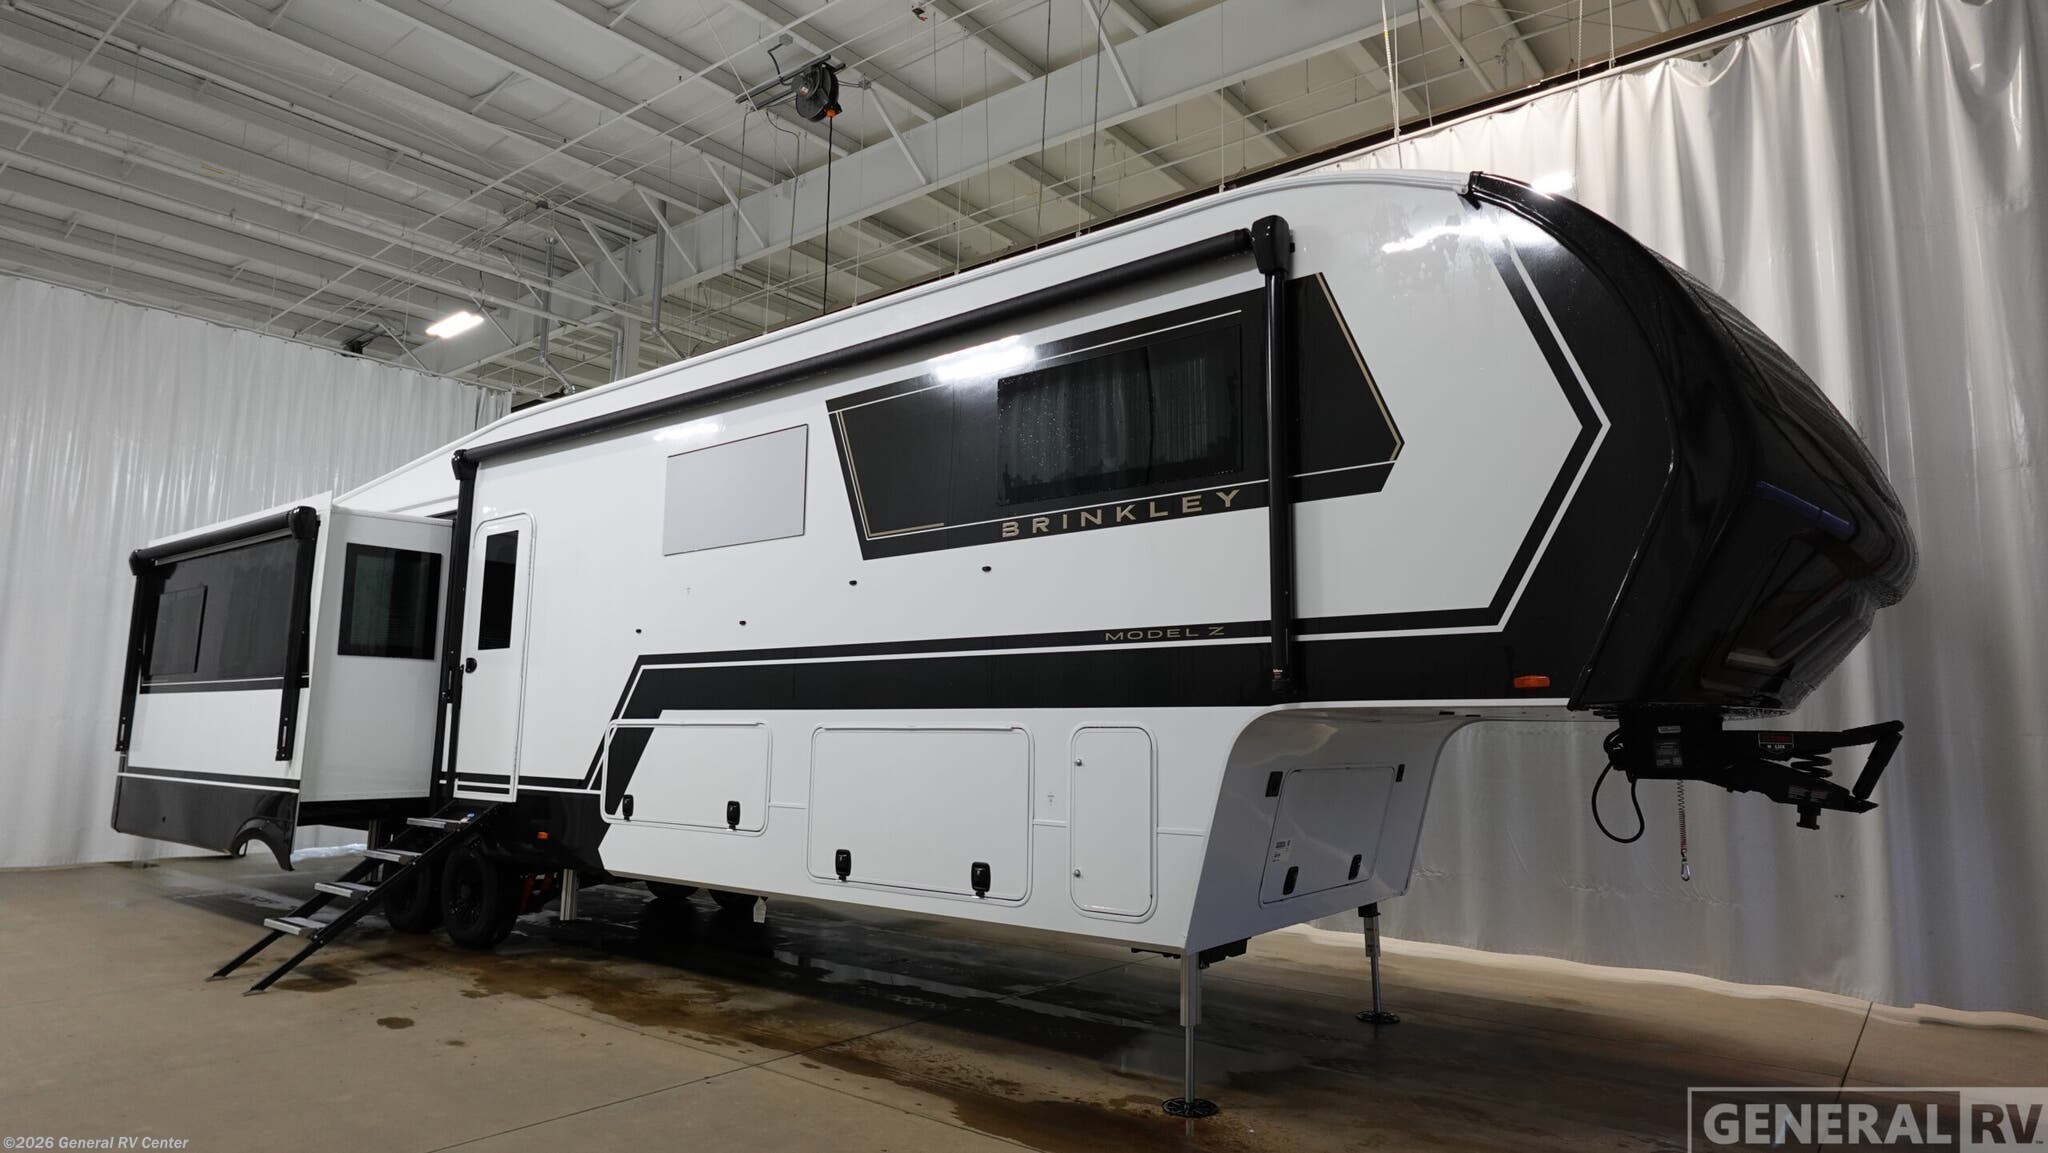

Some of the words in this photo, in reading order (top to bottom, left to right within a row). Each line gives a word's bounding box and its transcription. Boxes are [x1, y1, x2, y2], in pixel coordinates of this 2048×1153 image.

[1002, 489, 1240, 538] BRINKLEY
[1105, 627, 1200, 641] MODEL
[1208, 626, 1225, 636] Z
